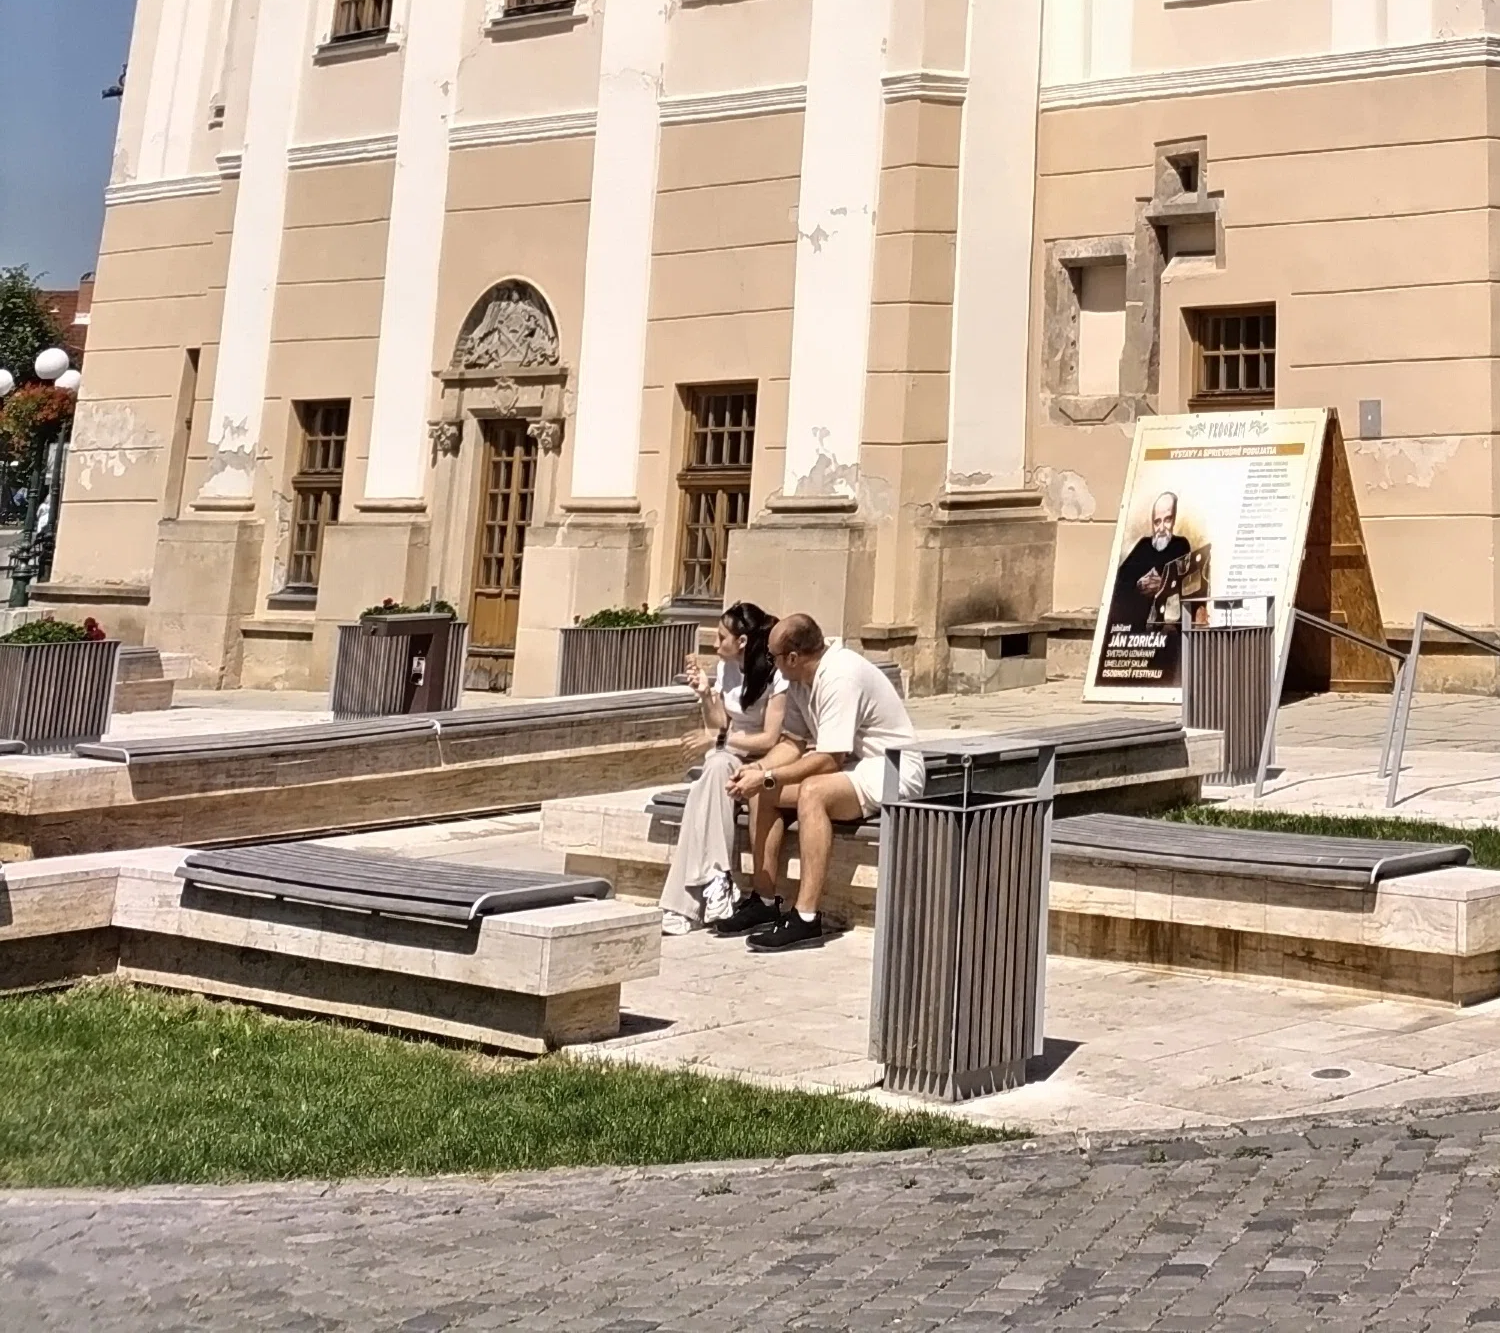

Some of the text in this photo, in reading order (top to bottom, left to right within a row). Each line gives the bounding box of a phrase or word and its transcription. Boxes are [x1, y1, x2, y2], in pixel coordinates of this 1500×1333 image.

[1208, 421, 1247, 439] PROGRAM
[1108, 632, 1167, 647] JÁN ZORIČÁK
[1132, 670, 1163, 678] FESTIVALU
